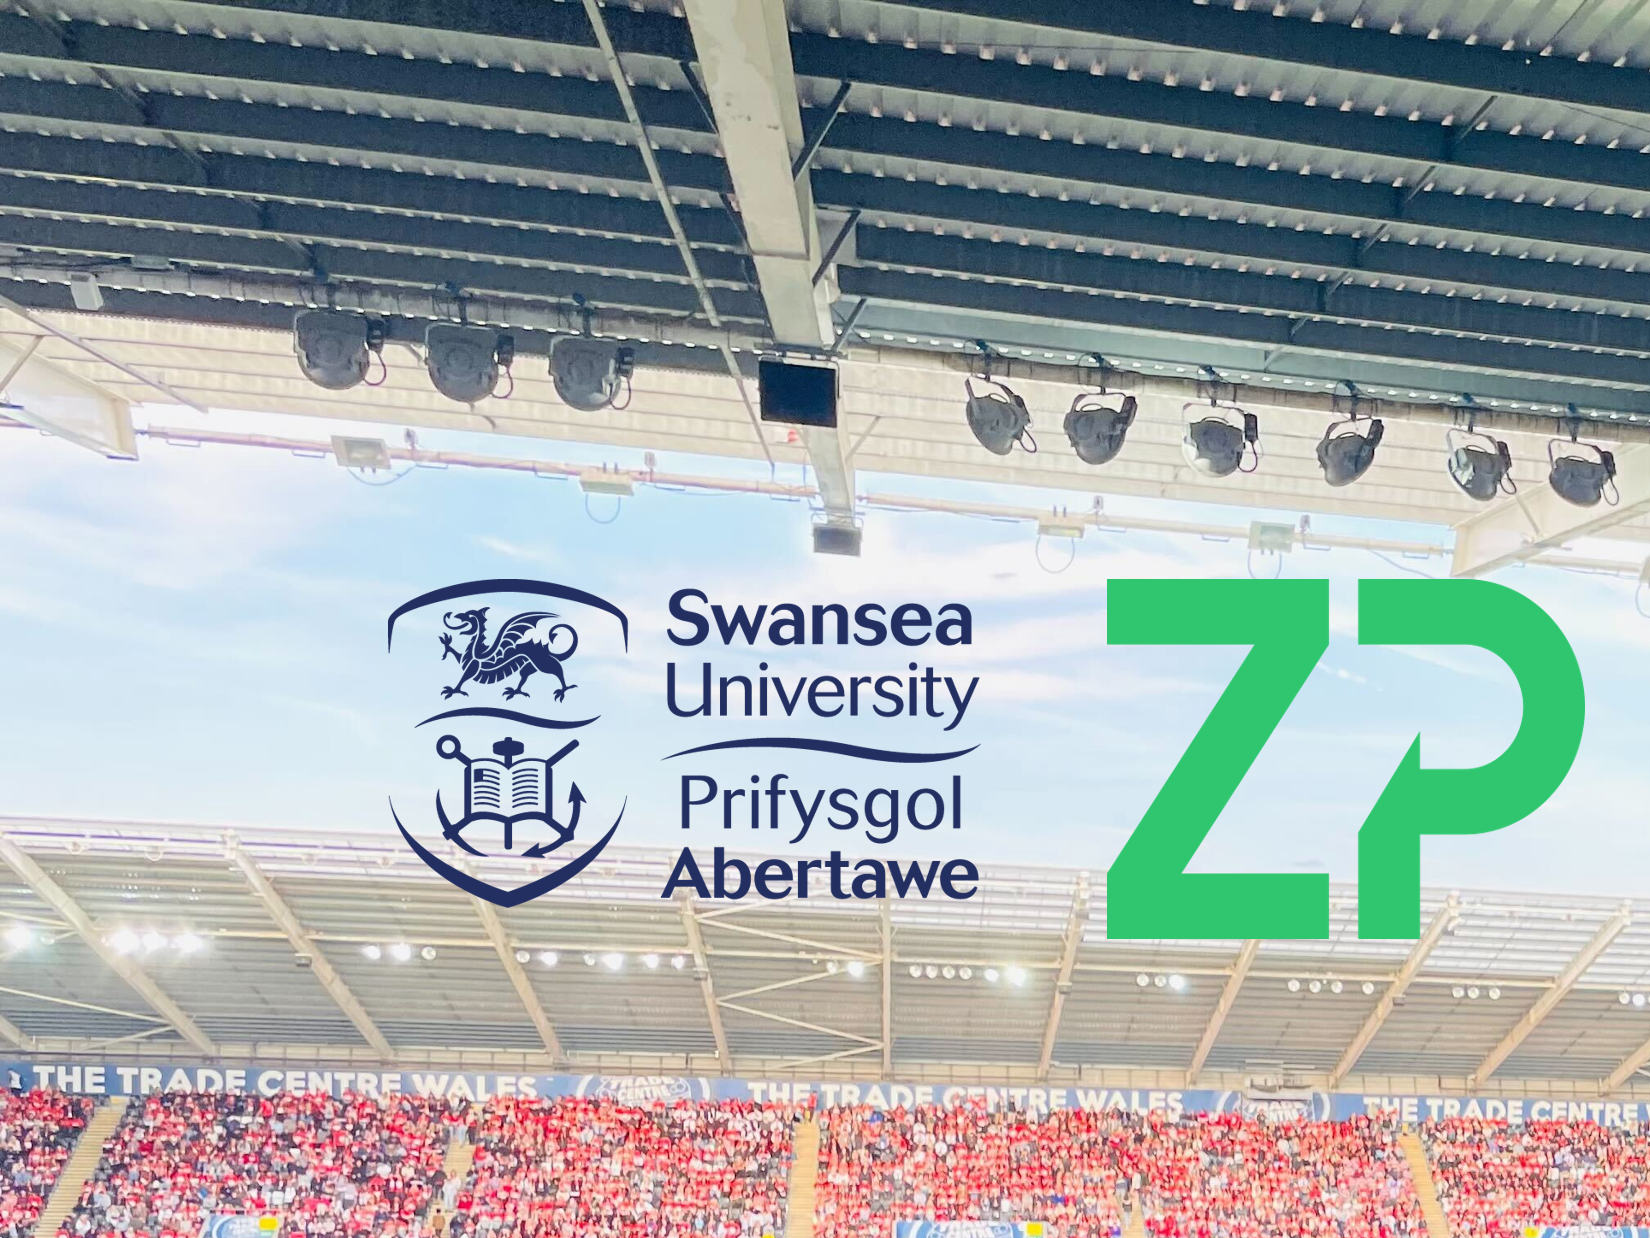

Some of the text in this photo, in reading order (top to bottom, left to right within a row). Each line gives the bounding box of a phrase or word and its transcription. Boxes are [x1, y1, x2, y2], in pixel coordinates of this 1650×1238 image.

[33, 1065, 537, 1101] THE TRADE CENTRE WALES
[748, 1082, 811, 1105] THE
[821, 1084, 934, 1110] TRADE
[1076, 1090, 1184, 1115] WALES
[1363, 1097, 1418, 1121] THE
[1426, 1099, 1525, 1122] TRADE
[1531, 1101, 1638, 1126] CENTRE
